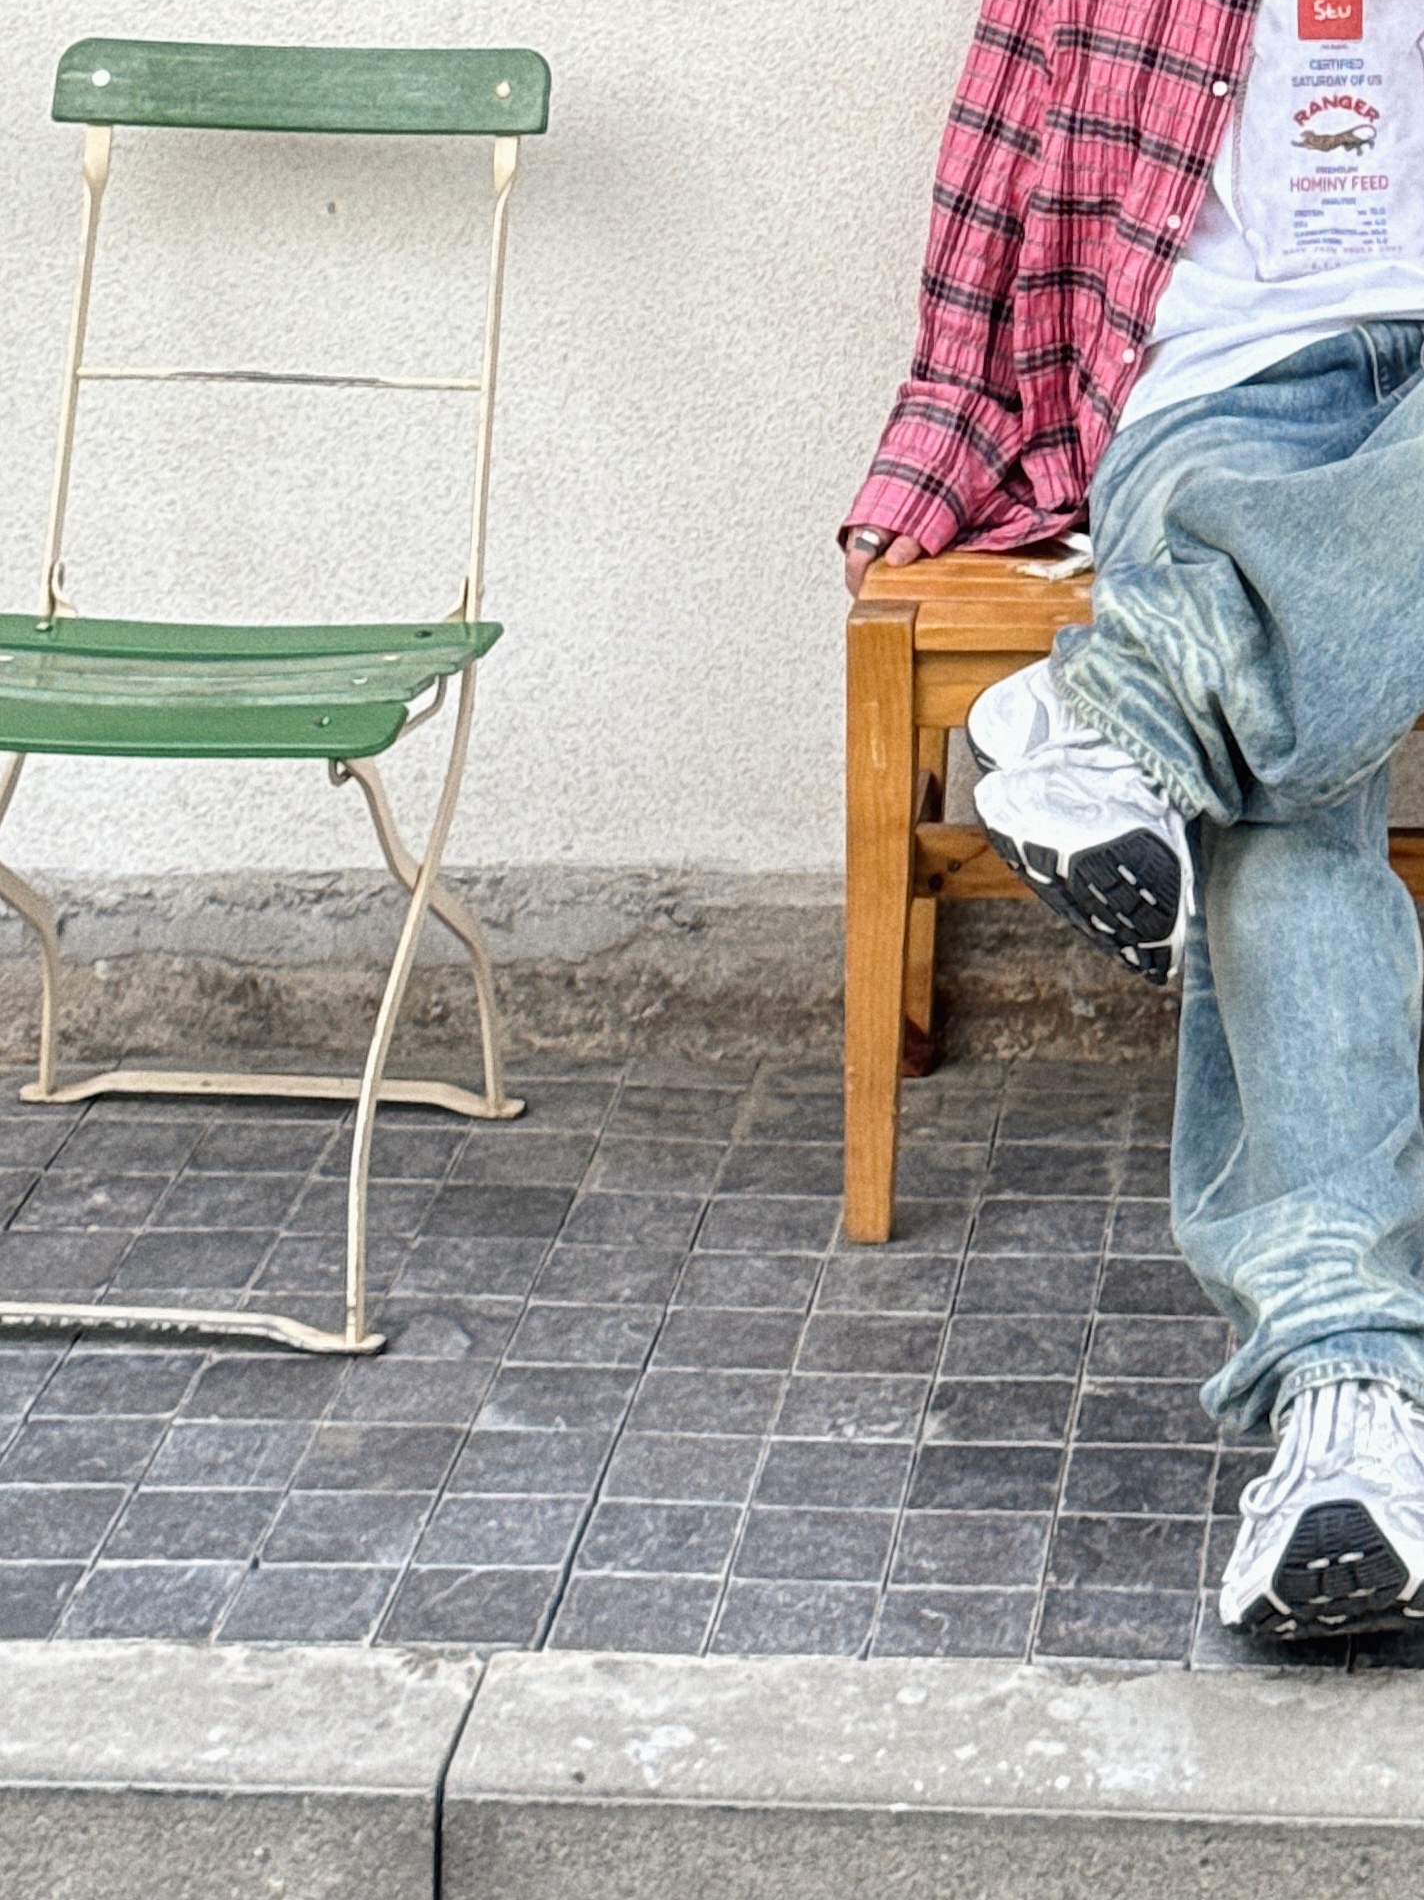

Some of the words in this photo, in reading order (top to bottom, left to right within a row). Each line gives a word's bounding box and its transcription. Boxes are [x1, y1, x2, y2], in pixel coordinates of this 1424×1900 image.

[1309, 58, 1364, 70] CERTIFIED
[1291, 74, 1348, 87] SATURDAY
[1350, 74, 1365, 87] OF
[1367, 74, 1382, 86] US
[1293, 94, 1380, 127] RANGER
[1290, 176, 1347, 193] HOMINY
[1351, 175, 1389, 191] FEED
